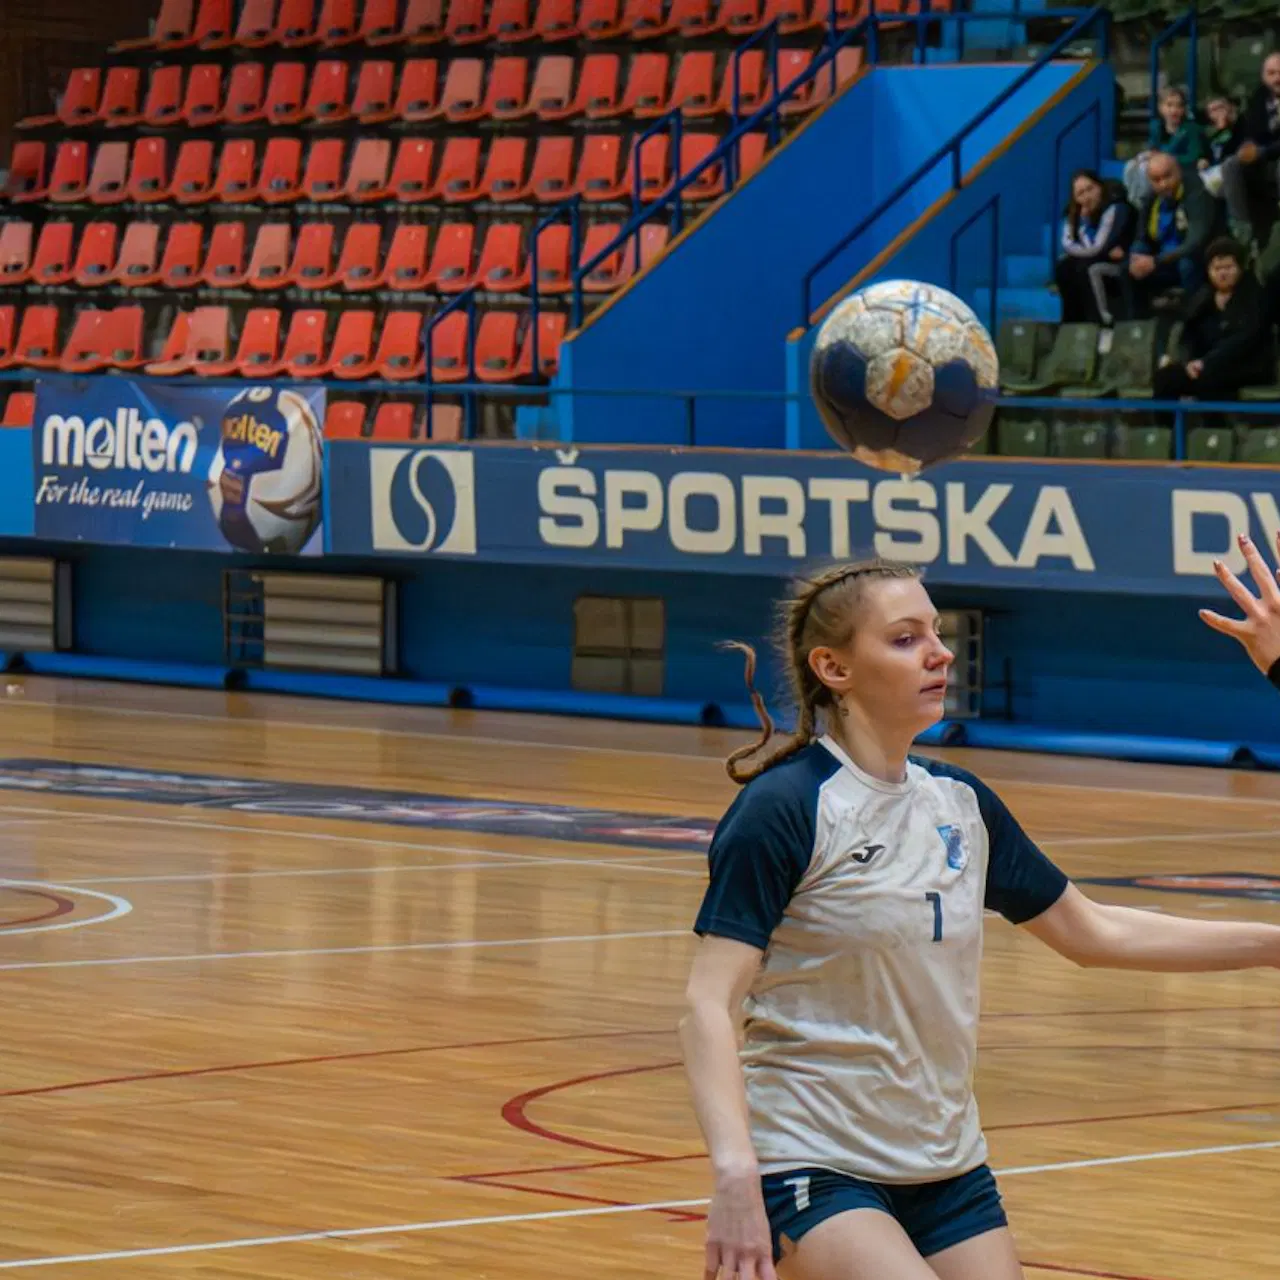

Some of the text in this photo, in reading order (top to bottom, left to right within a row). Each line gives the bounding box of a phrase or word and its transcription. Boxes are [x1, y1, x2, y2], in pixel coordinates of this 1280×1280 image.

[42, 407, 198, 474] molten
[35, 475, 193, 521] For the real game
[925, 891, 943, 943] 1
